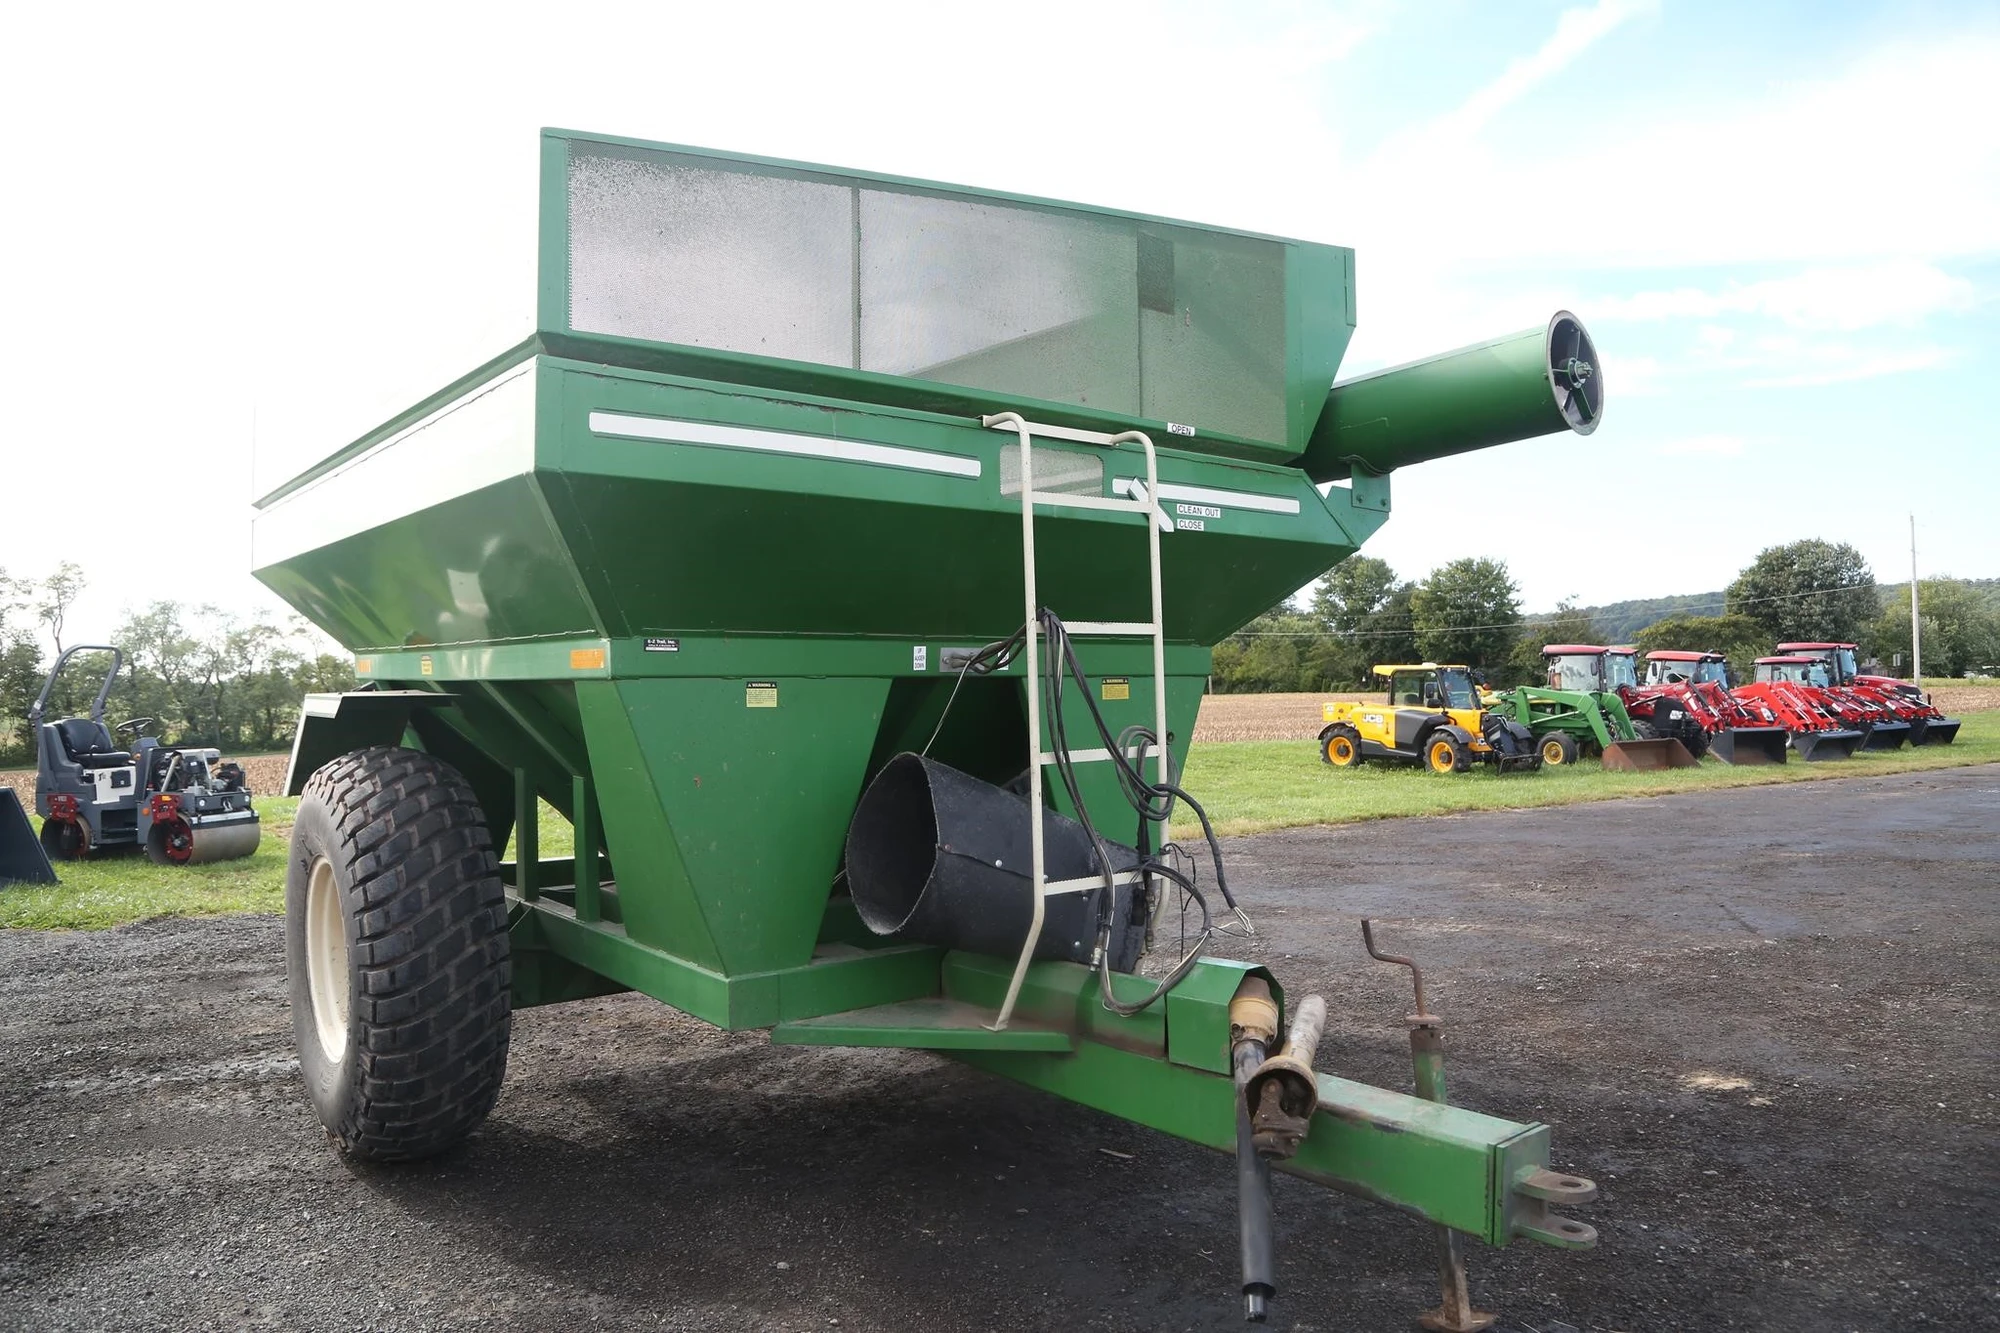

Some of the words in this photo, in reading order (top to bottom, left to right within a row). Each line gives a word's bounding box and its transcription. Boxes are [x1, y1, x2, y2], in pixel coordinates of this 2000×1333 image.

[1171, 424, 1191, 435] OPEN
[1178, 504, 1202, 515] CLEAN
[1205, 507, 1219, 517] OUT
[1179, 519, 1202, 530] CLOSE
[1362, 713, 1384, 723] JCB
